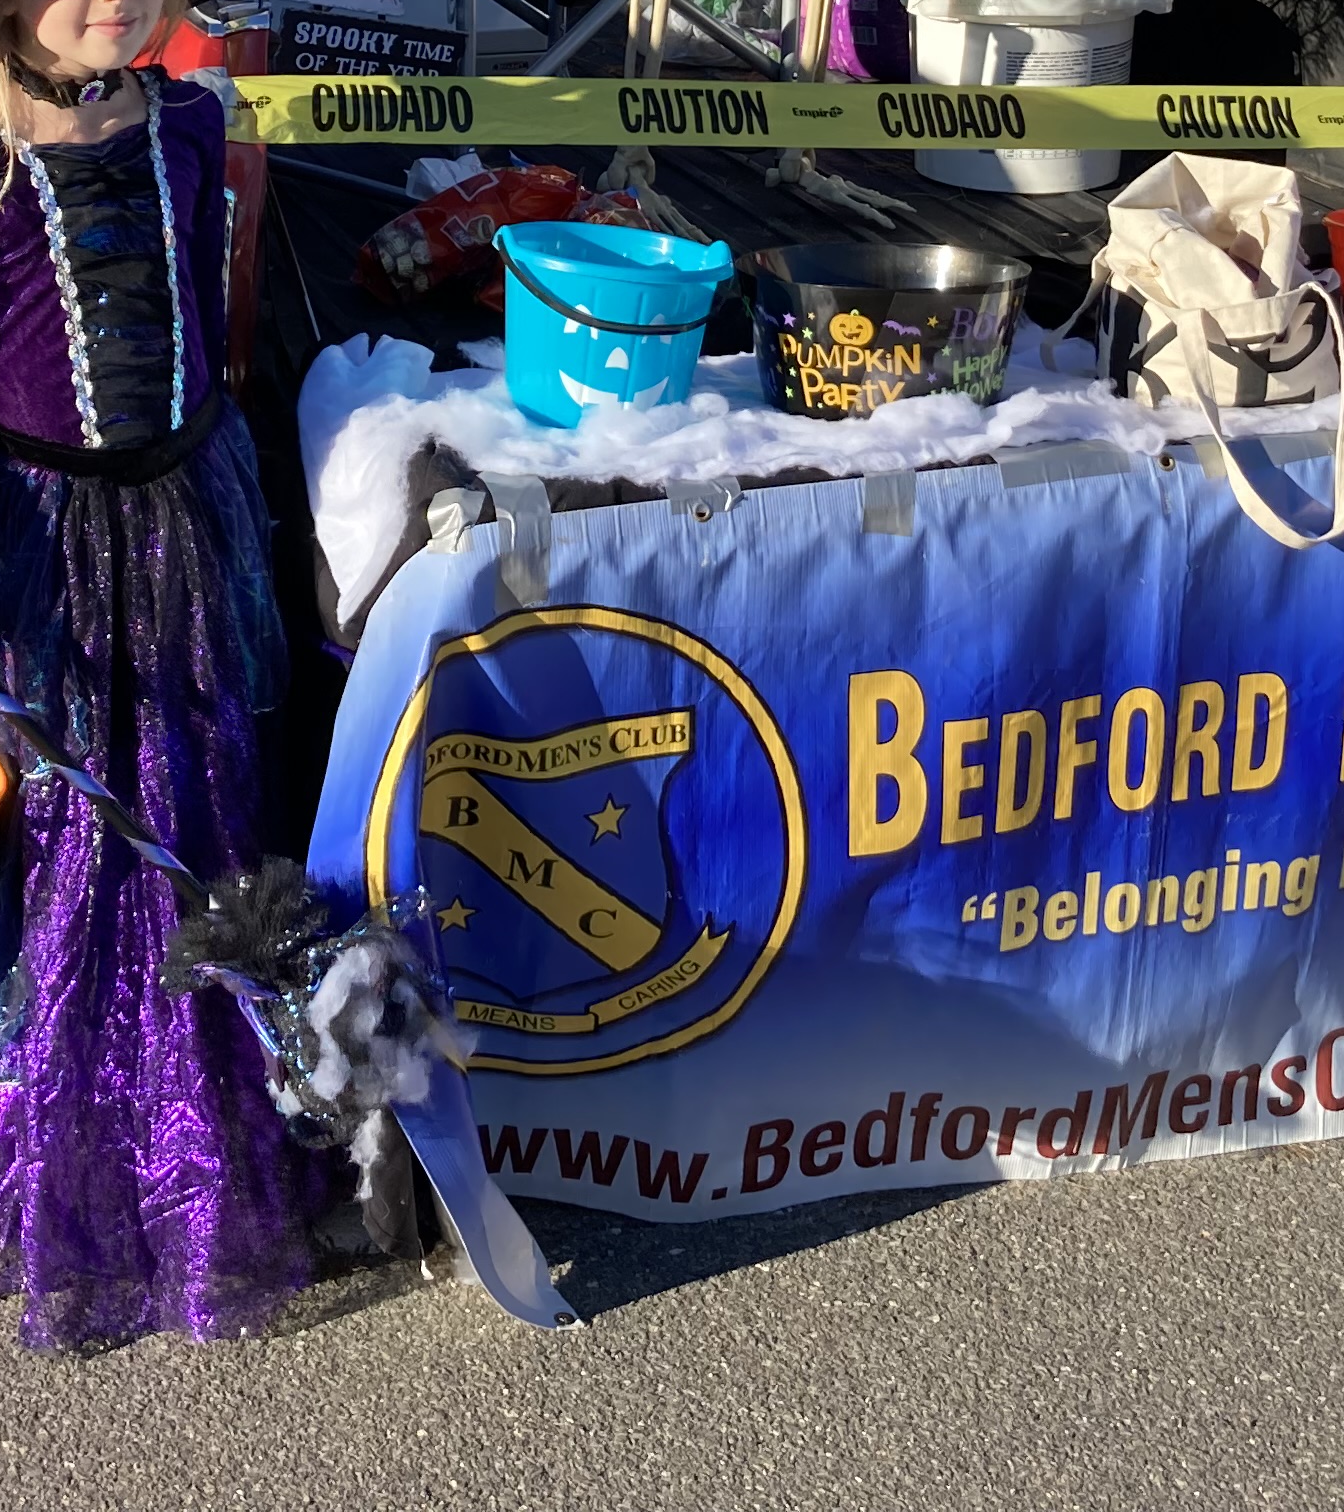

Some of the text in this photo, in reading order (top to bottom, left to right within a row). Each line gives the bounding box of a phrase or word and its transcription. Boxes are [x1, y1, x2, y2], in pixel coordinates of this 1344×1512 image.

[294, 21, 455, 63] SPOOKY TIME
[295, 52, 328, 72] OF
[335, 56, 379, 76] THE
[311, 83, 474, 134] CUIDADO
[617, 86, 770, 136] CAUTION
[792, 104, 844, 120] Empire
[877, 91, 1027, 140] CUIDADO
[1156, 93, 1301, 140] CAUTION
[514, 734, 602, 773] MEN'S
[609, 723, 687, 754] CLUB
[848, 668, 1289, 858] BEDFORD
[444, 795, 618, 939] B M C
[960, 848, 1321, 953] "Belonging
[468, 958, 701, 1031] MEANS CARING
